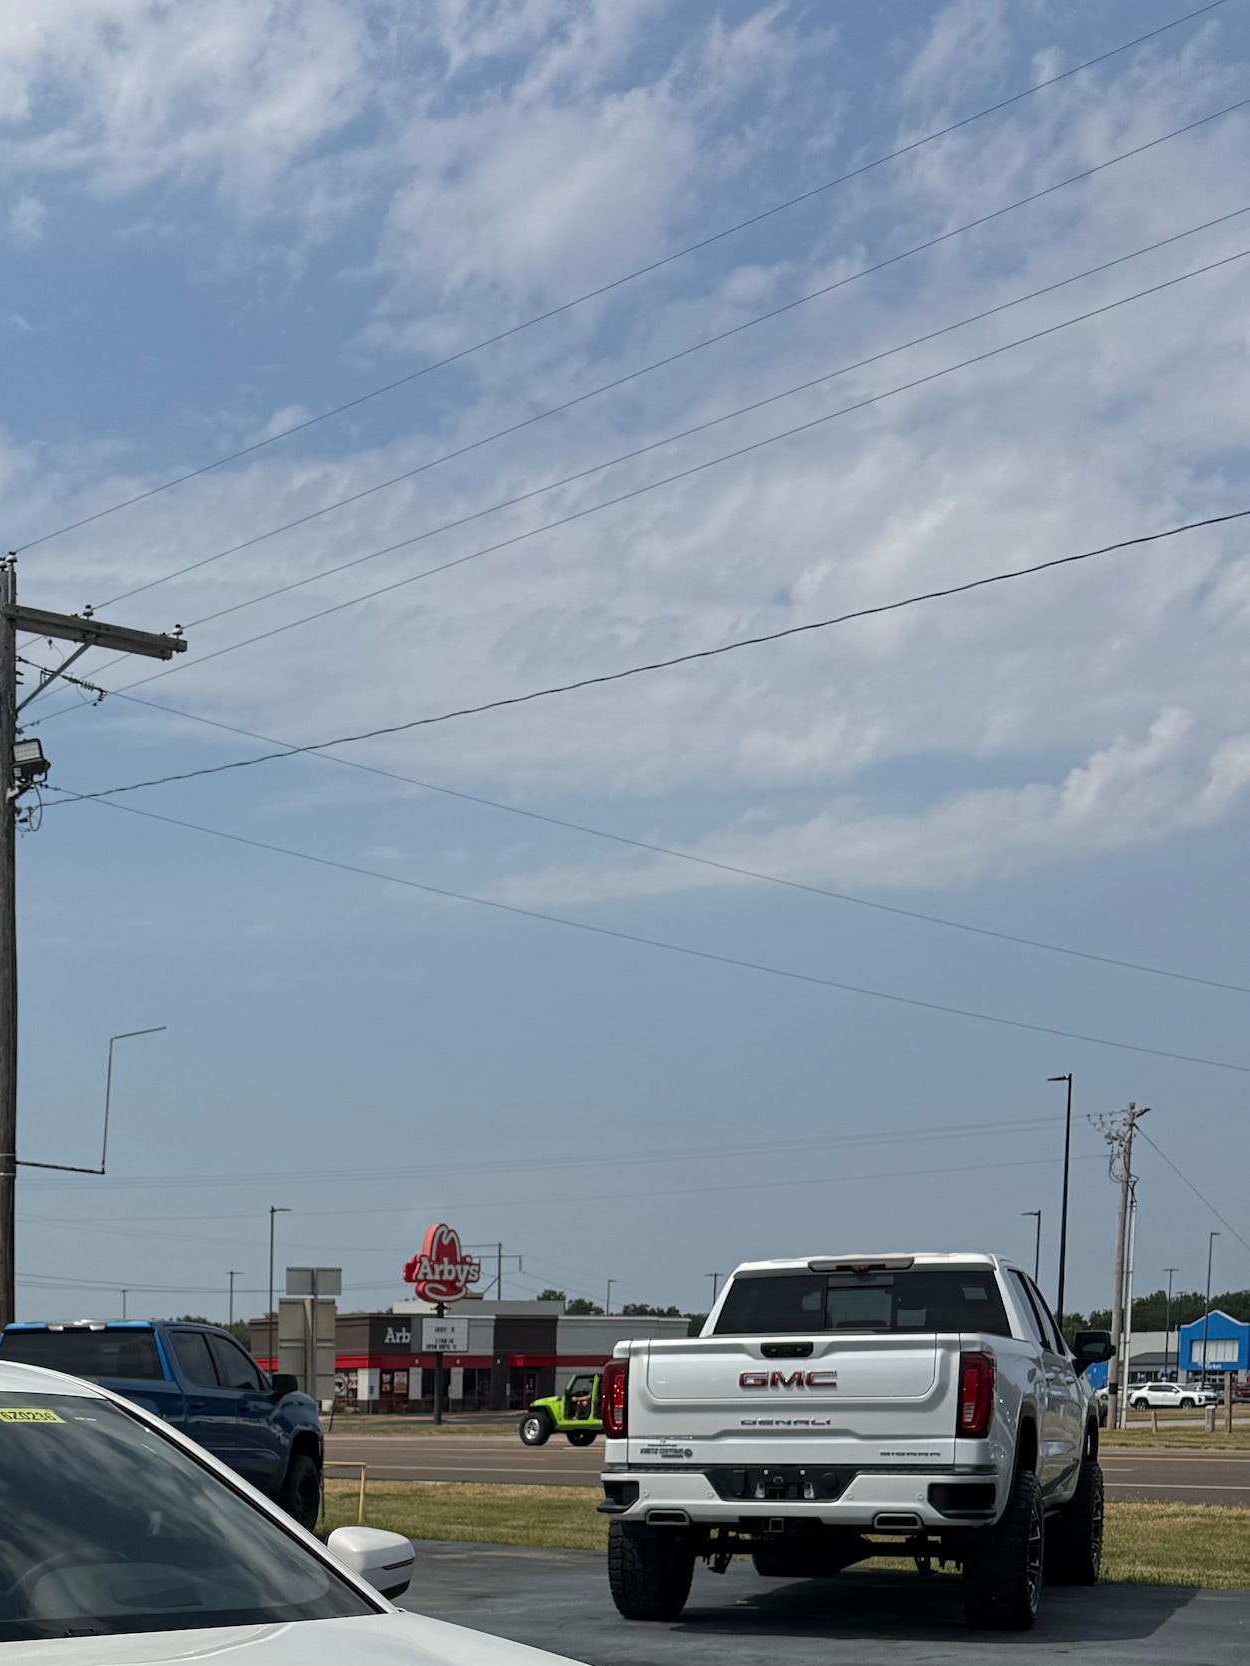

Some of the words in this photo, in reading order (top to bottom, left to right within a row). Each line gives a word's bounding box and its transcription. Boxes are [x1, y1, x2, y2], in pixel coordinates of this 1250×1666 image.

[416, 1255, 480, 1288] Arby's
[739, 1370, 837, 1389] GMC
[740, 1418, 831, 1426] DENALI
